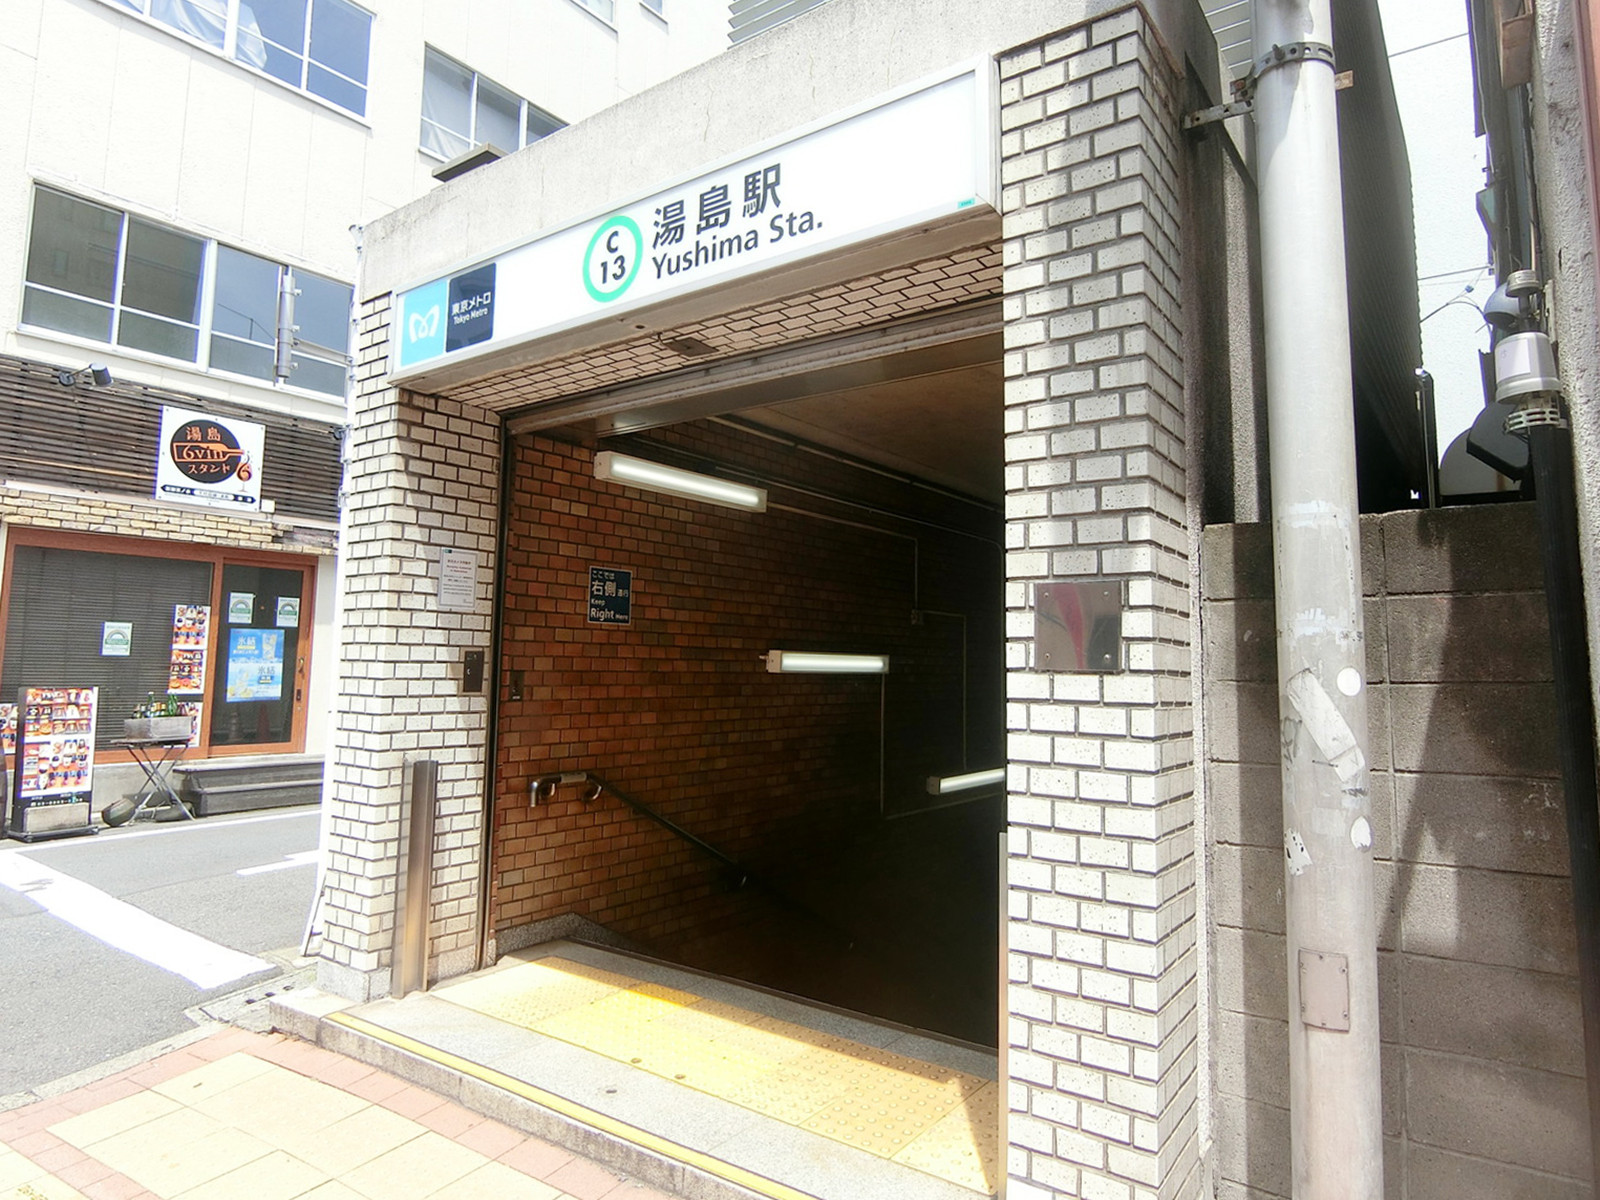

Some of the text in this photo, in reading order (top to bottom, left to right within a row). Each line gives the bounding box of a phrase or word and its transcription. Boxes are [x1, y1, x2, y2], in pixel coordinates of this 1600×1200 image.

[652, 163, 782, 250] 湯島駅
[606, 230, 619, 254] C
[651, 211, 823, 280] Yushima Sta.
[600, 254, 626, 285] 13
[451, 291, 492, 317] 東京メトロ
[453, 307, 488, 325] Tokyo Metro
[186, 426, 221, 441] 湯島
[188, 463, 230, 474] スタンド
[591, 608, 614, 621] Right
